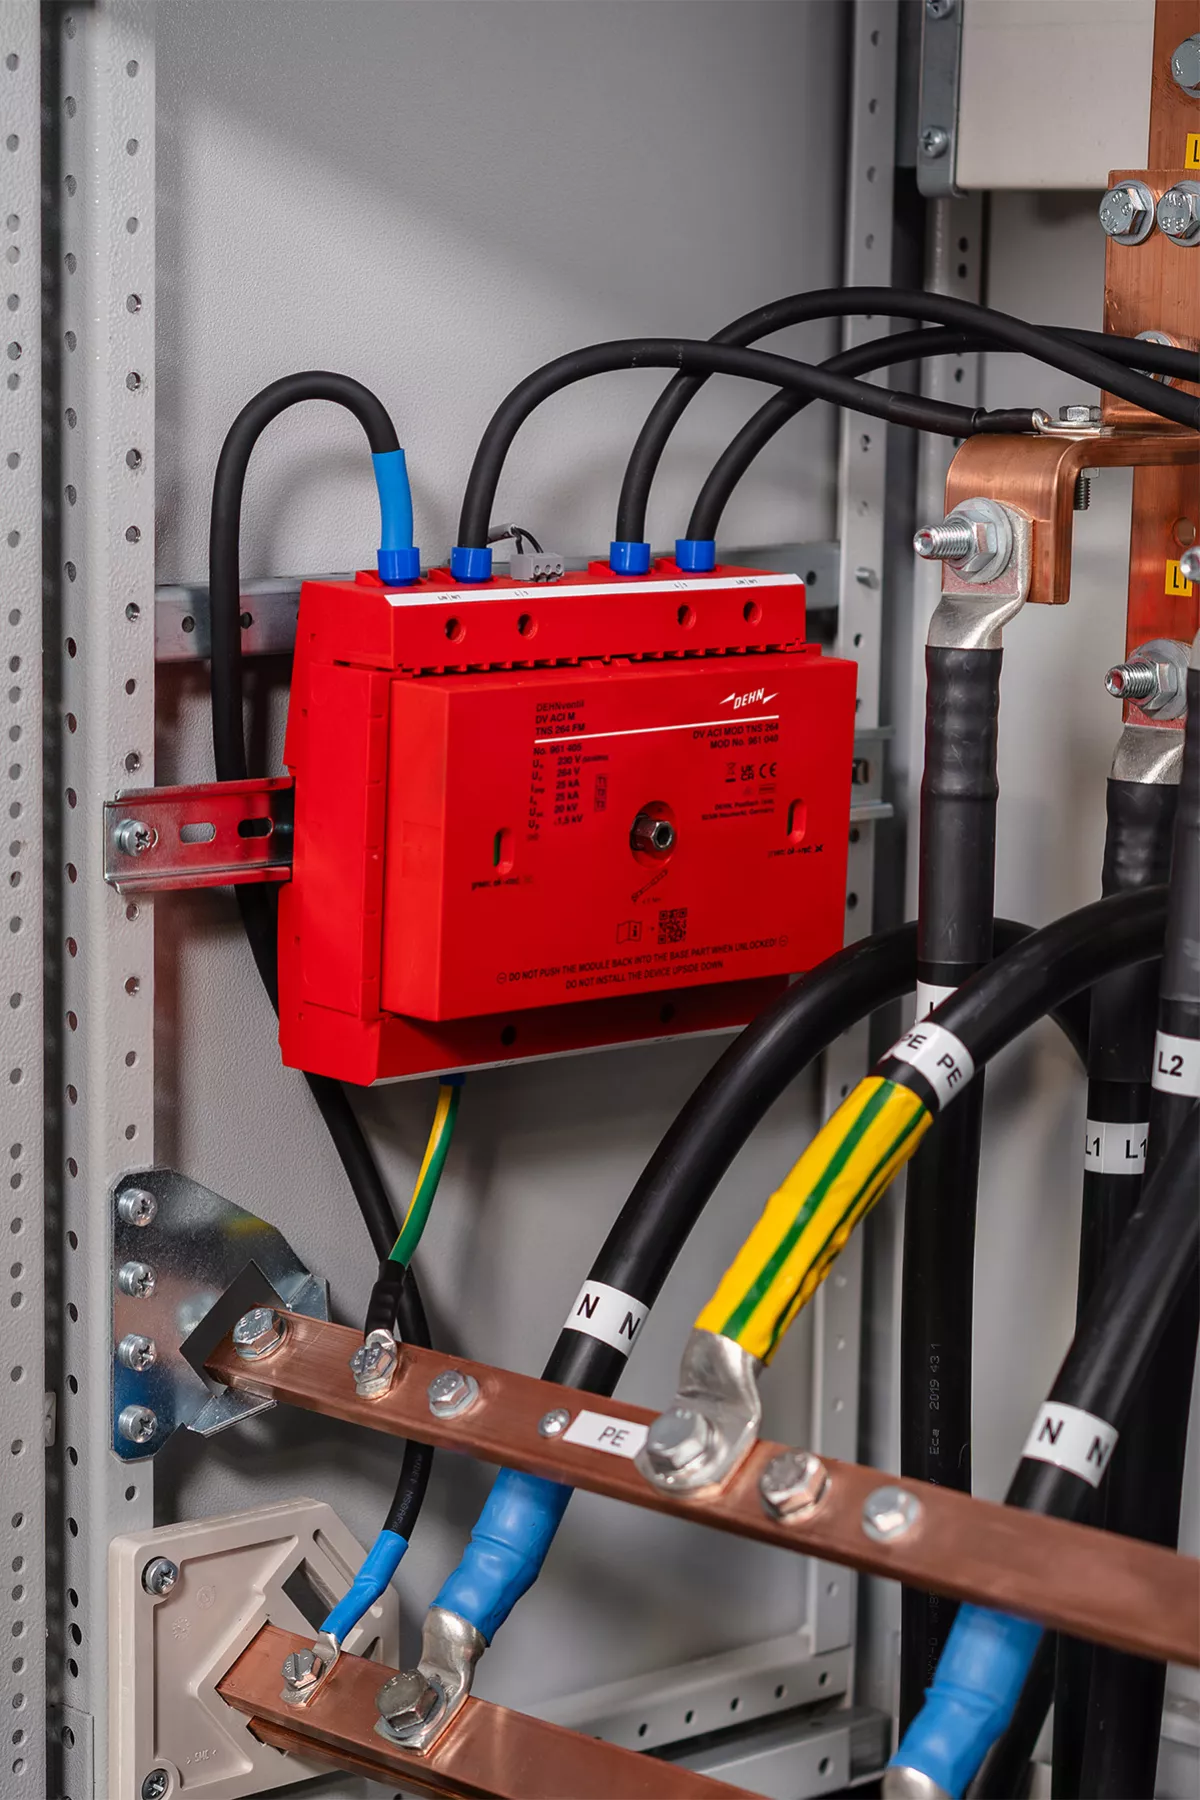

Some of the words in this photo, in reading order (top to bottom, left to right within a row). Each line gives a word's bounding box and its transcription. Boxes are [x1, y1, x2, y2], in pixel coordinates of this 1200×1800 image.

[733, 687, 765, 710] DEHN
[535, 714, 549, 725] DV
[549, 712, 566, 723] ACI
[535, 726, 553, 735] TNS
[692, 730, 705, 739] DV
[707, 728, 722, 737] ACI
[723, 725, 744, 736] MOD
[746, 724, 763, 733] TNS
[710, 739, 730, 749] MOD
[509, 972, 520, 982] DO
[522, 969, 538, 980] NOT
[539, 967, 561, 977] PUSH
[562, 964, 577, 975] THE
[578, 960, 610, 972] MODULE
[611, 957, 633, 969] BACK
[634, 955, 652, 965] INTO
[654, 952, 668, 963] THE
[669, 949, 690, 960] BASE
[691, 947, 711, 957] PART
[711, 943, 733, 954] WHEN
[565, 979, 577, 989] DO
[578, 976, 595, 987] NOT
[595, 973, 626, 985] INSTALL
[627, 970, 642, 981] THE
[643, 967, 671, 979] DEVICE
[672, 963, 699, 975] UPSIDE
[700, 960, 724, 971] DOWN
[936, 1053, 963, 1089] PE
[1158, 1051, 1184, 1077] L2
[1125, 1138, 1148, 1159] L1
[576, 1293, 601, 1319] N
[618, 1311, 641, 1341] N
[929, 1379, 940, 1410] 2019
[599, 1426, 630, 1448] PE
[1038, 1417, 1065, 1445] N
[1086, 1436, 1109, 1468] N
